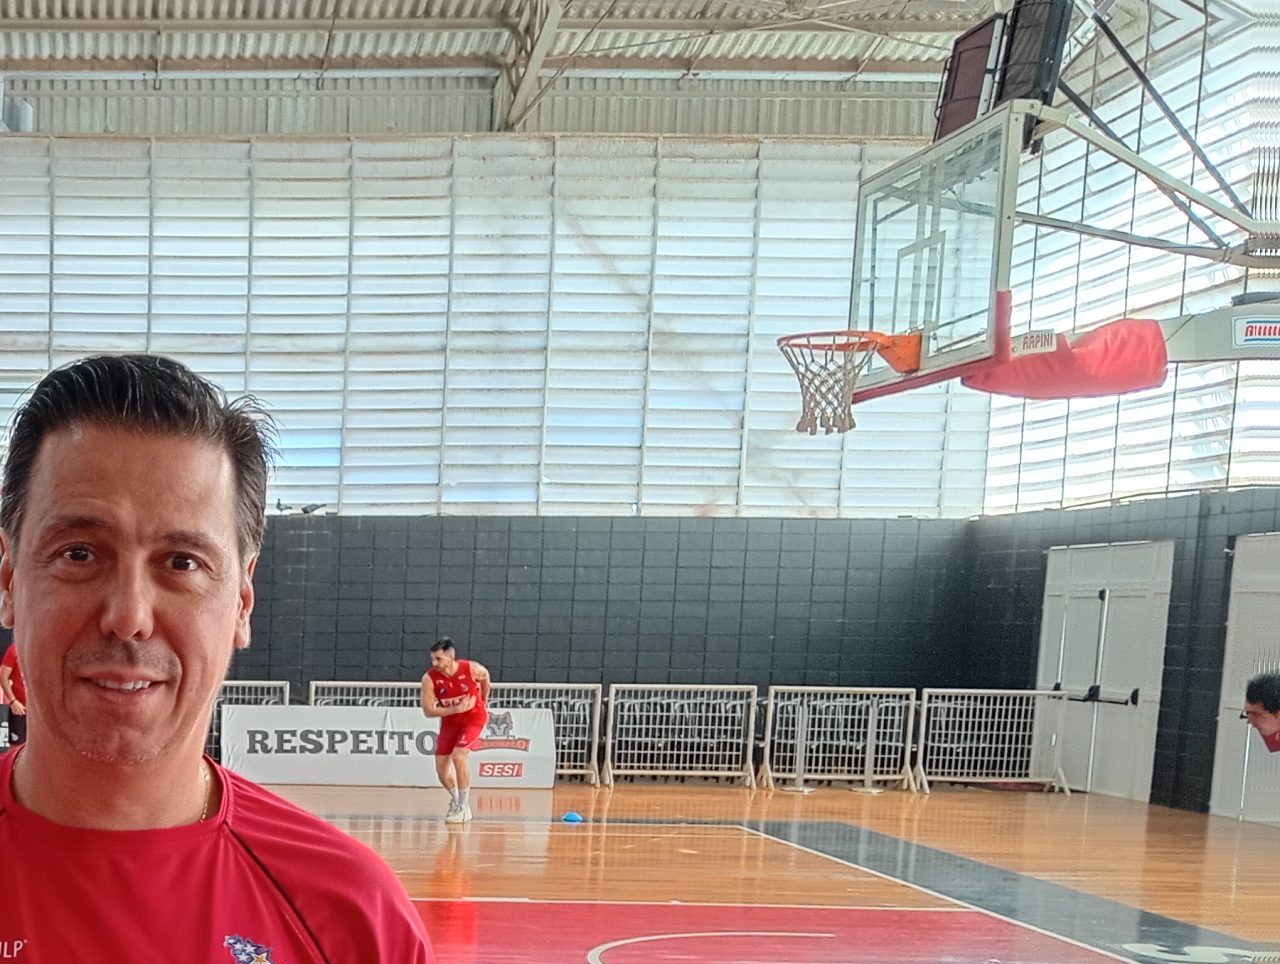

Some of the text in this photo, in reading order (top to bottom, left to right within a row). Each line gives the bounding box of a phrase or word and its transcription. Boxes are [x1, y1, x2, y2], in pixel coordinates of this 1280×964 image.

[1023, 330, 1054, 351] RAPINI
[246, 729, 438, 755] RESPEITO
[481, 764, 519, 776] SESI
